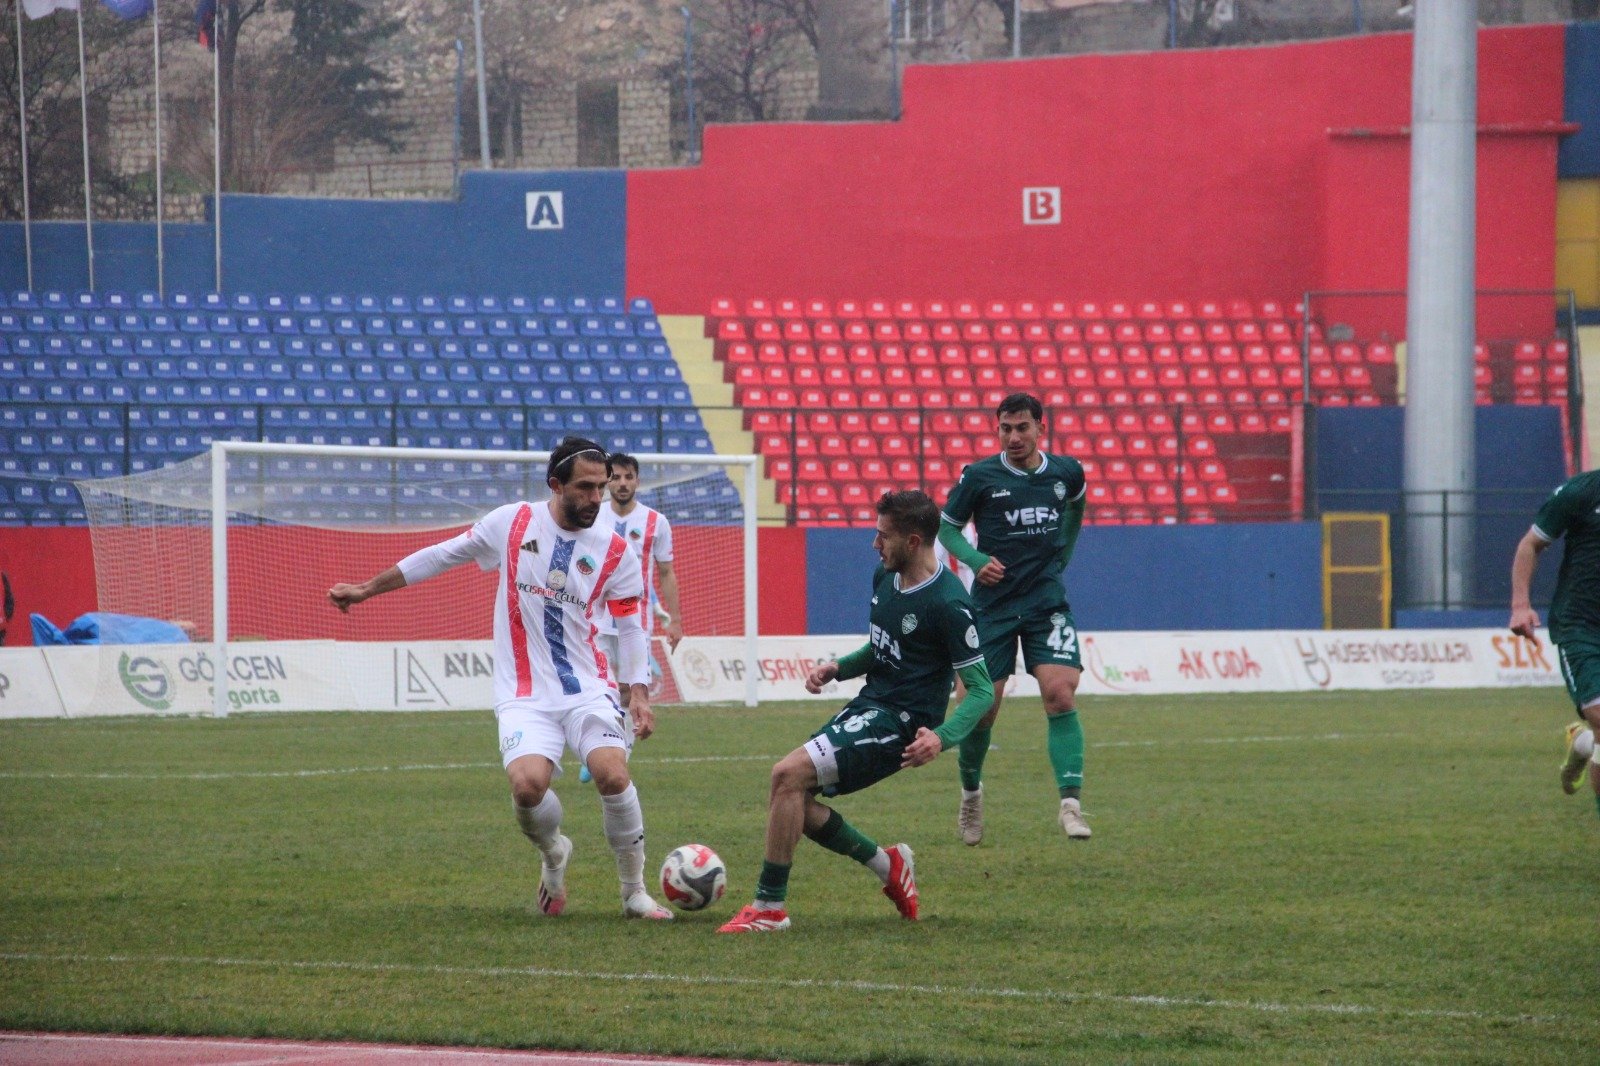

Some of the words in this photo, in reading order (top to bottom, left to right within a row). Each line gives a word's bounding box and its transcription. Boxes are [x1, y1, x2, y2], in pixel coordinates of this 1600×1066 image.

[530, 195, 560, 226] A
[1029, 191, 1055, 220] B
[1046, 624, 1076, 653] 42
[178, 651, 287, 686] GÖÇEN
